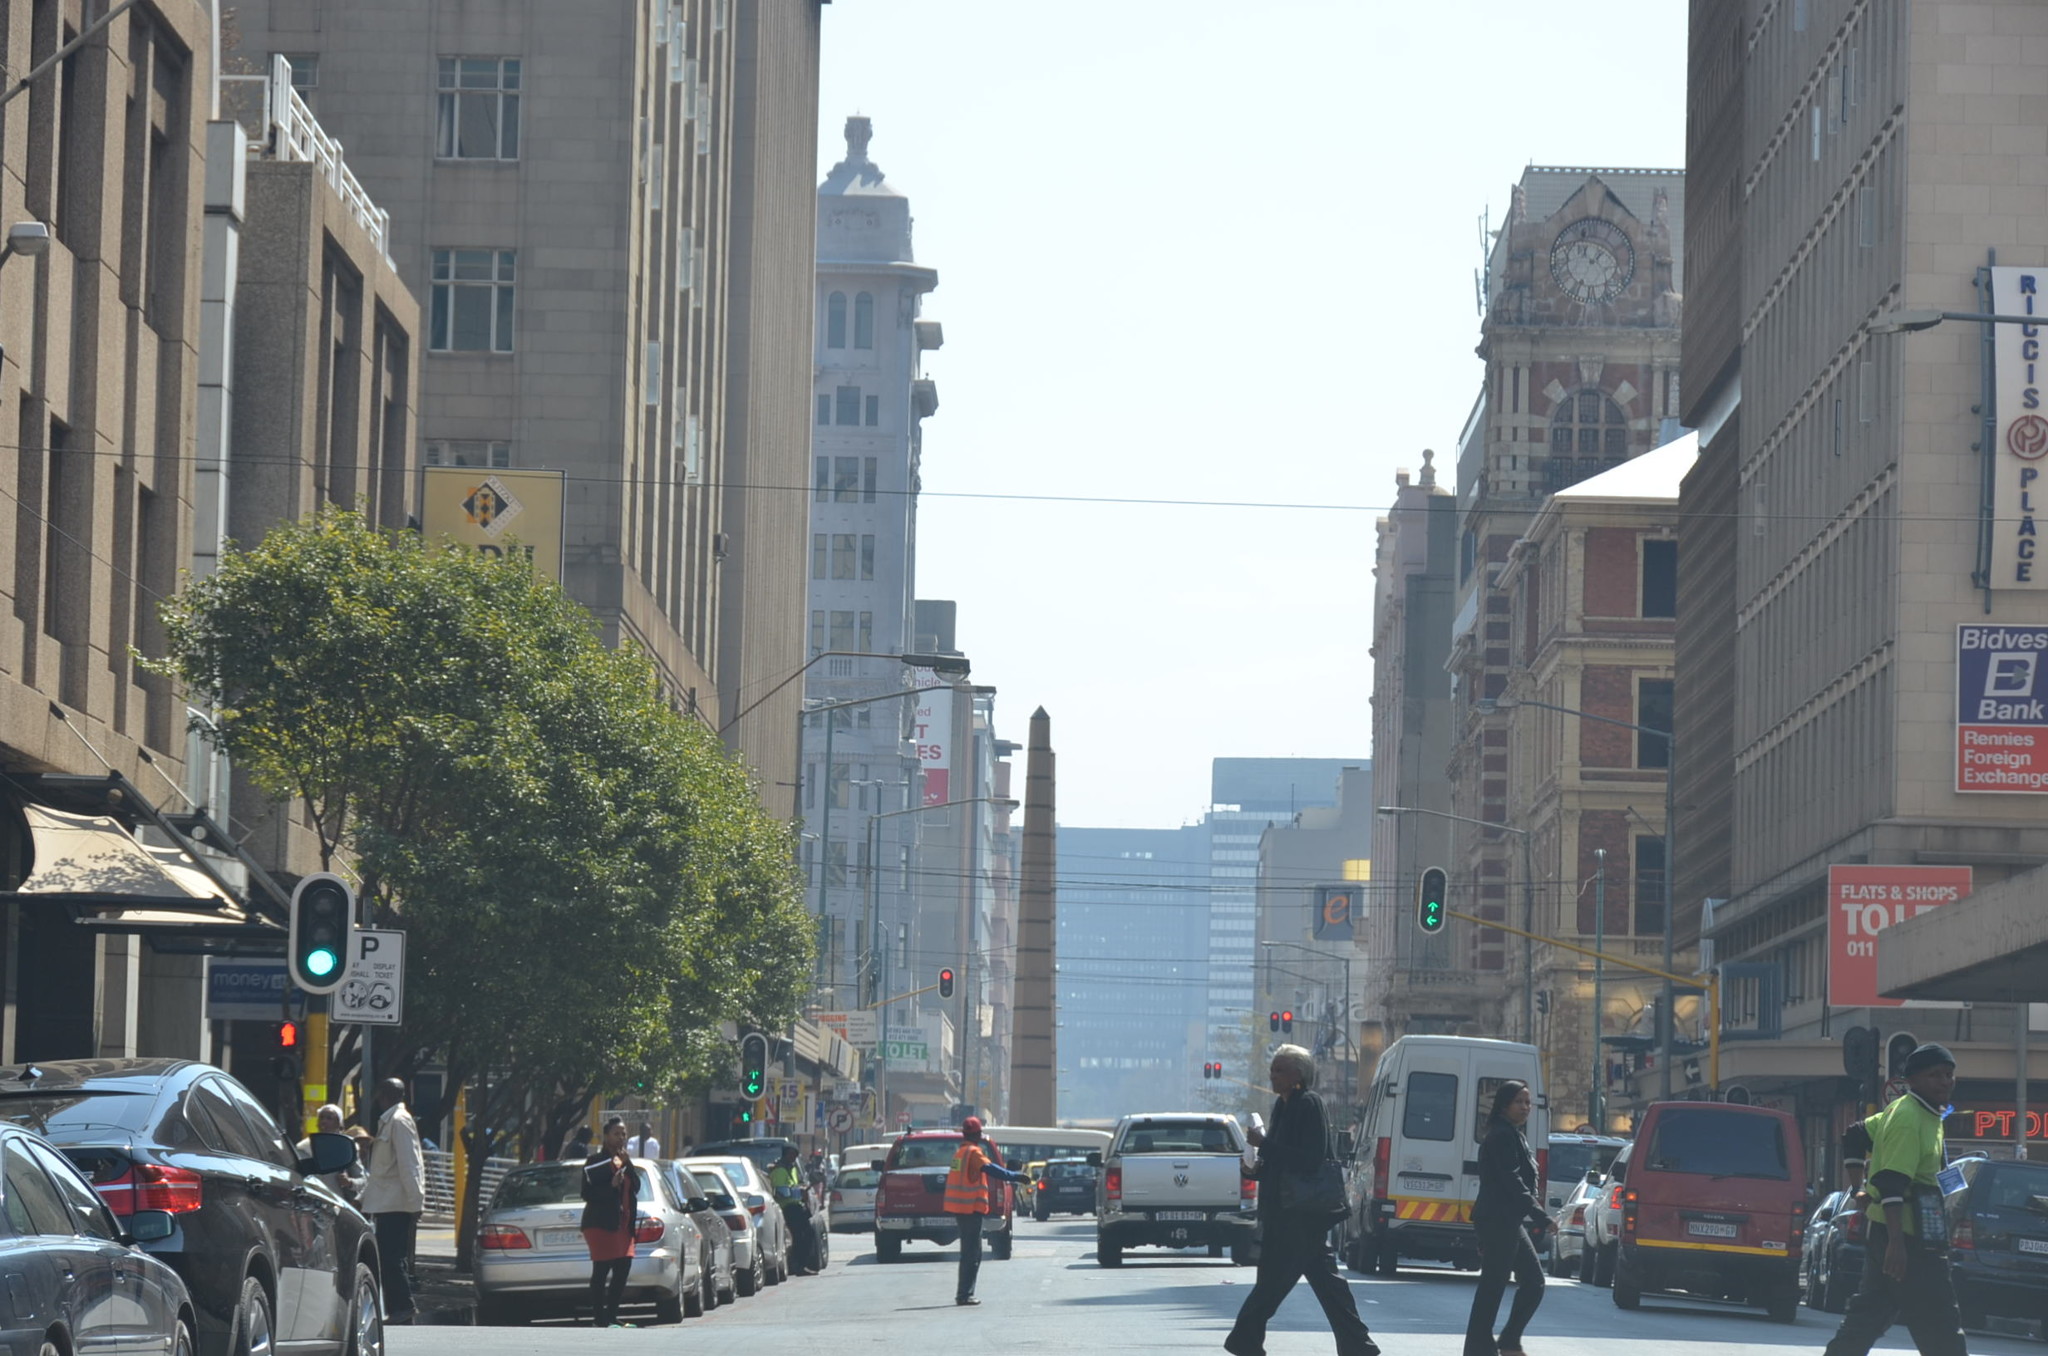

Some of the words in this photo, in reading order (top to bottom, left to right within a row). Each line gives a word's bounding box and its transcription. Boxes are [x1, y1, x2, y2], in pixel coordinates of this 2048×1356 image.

[2020, 275, 2039, 409] RICCIS
[2016, 467, 2038, 582] PLACE
[1978, 699, 2046, 720] Bank
[1964, 730, 2035, 746] Rennies
[1964, 749, 2031, 768] Foreign
[1841, 884, 1887, 899] FLATS
[1891, 885, 1903, 900] &
[1906, 886, 1958, 900] SHOPS
[1841, 903, 1889, 936] TO
[360, 936, 379, 960] P
[1846, 940, 1874, 957] 011
[374, 971, 394, 979] TICKET
[903, 1043, 926, 1059] LET
